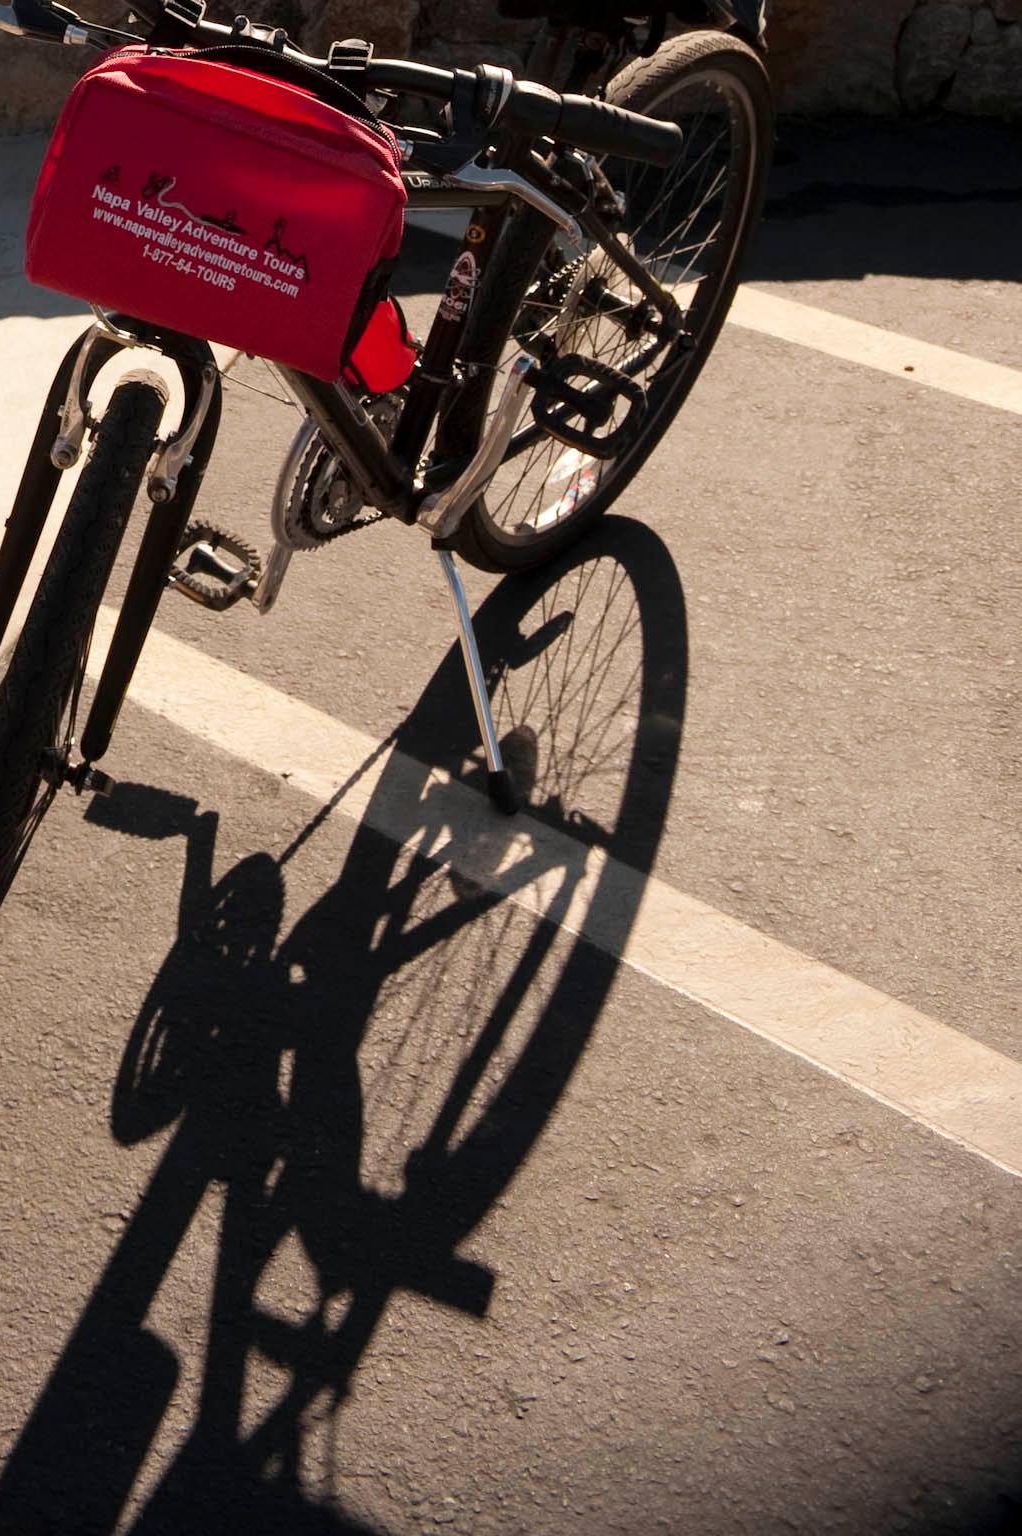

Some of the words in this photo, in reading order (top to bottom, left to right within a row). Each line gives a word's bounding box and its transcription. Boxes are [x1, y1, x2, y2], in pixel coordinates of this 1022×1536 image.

[91, 184, 131, 211] Napa
[137, 200, 182, 232] Valley
[181, 221, 258, 261] Adventure
[263, 251, 306, 281] Tours
[92, 207, 300, 299] www.napavalleyadventuretours.com
